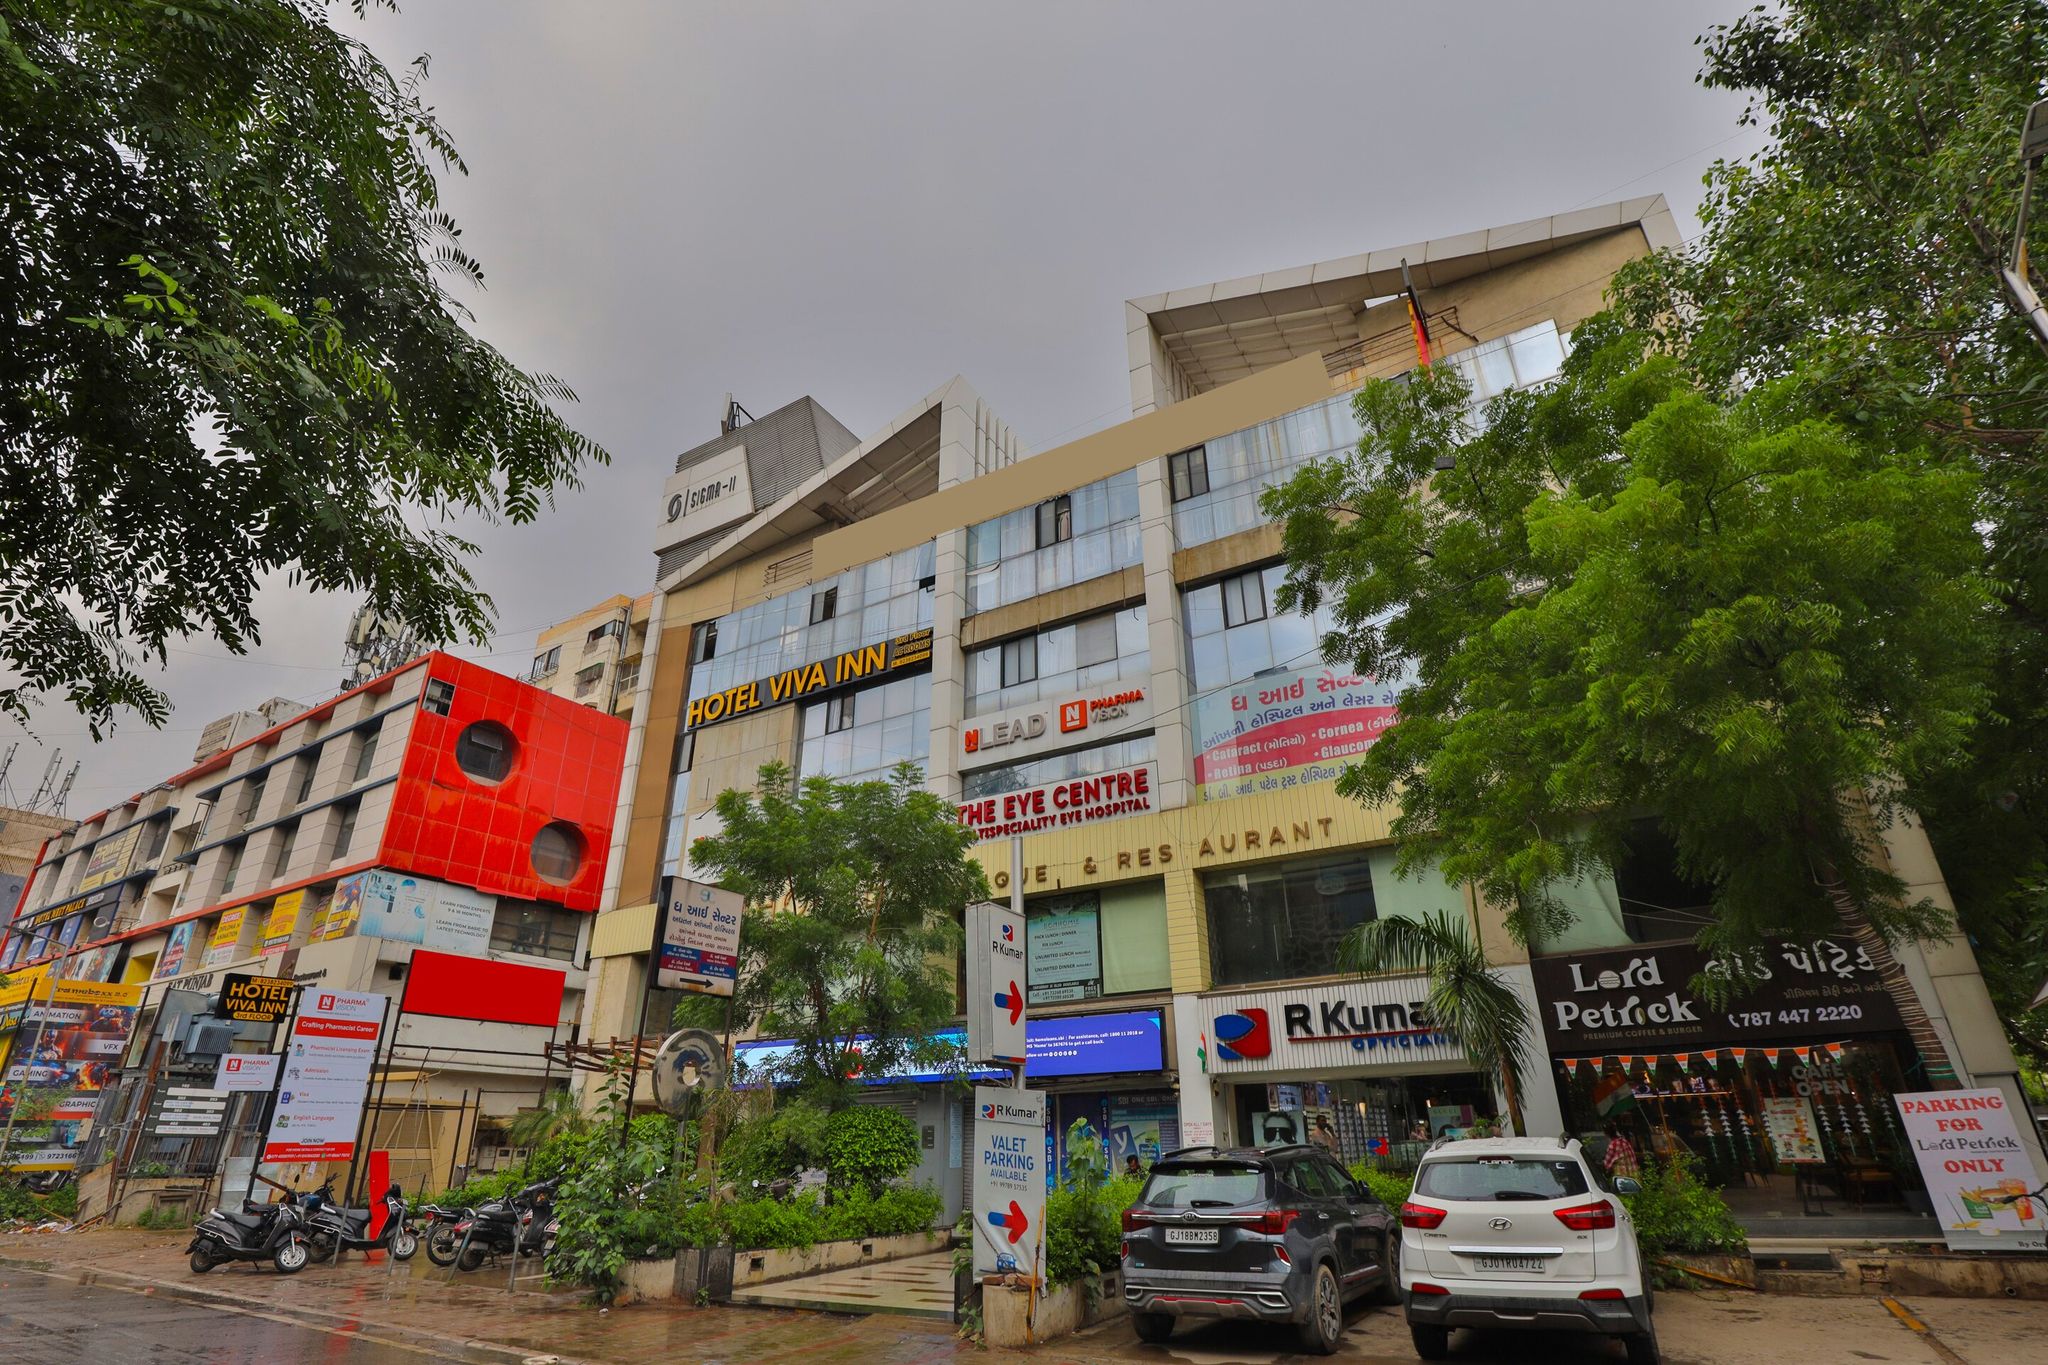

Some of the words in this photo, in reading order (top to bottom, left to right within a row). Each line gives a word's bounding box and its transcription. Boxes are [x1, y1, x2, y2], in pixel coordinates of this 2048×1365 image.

[904, 639, 931, 653] ROOMS
[688, 682, 761, 727] HOTEL
[769, 662, 828, 702] VIVA
[835, 642, 887, 683] INN
[1259, 677, 1305, 705] આઈ
[1090, 689, 1145, 712] PHARMA
[1310, 695, 1336, 712] અને
[1090, 704, 1129, 723] VISION
[1318, 722, 1364, 740] Cornea
[1212, 742, 1262, 762] Cataract
[1214, 764, 1253, 779] Retina
[957, 799, 997, 827] THE
[1004, 789, 1046, 819] EYE
[1053, 767, 1150, 809] CENTRE
[1060, 809, 1083, 825] EYE
[1085, 797, 1151, 820] HOSPITAL
[1083, 857, 1097, 875] &
[470, 906, 491, 914] EXPERTS
[687, 905, 709, 919] આઈ
[454, 929, 486, 938] TECHNOLOGY
[992, 941, 999, 953] R
[999, 941, 1024, 960] Kumar
[1034, 965, 1058, 973] UNLIMITED
[183, 974, 214, 991] PUNJAB
[230, 982, 289, 1001] HOTEL
[225, 998, 257, 1012] VIVA
[259, 1001, 286, 1014] INN
[335, 1004, 358, 1012] VISION
[336, 997, 367, 1007] PHARMA
[33, 1010, 82, 1020] ANMATION
[235, 1012, 248, 1020] 3rd
[248, 1013, 272, 1021] FLOOR
[1284, 1003, 1314, 1038] R
[1321, 1000, 1437, 1035] Kuma
[1553, 992, 1700, 1031] Petrick
[1740, 1011, 1772, 1027] 787
[1778, 1009, 1810, 1024] 447
[1815, 1004, 1863, 1022] 2220
[301, 1020, 324, 1030] Crafting
[325, 1023, 356, 1032] Pharmacist
[357, 1025, 375, 1033] Career
[1583, 1031, 1623, 1041] PREMIUM
[1625, 1028, 1657, 1038] COFFEE
[1667, 1026, 1703, 1034] BURGER
[103, 1043, 119, 1051] VFX
[1791, 1064, 1844, 1080] CAFE
[1796, 1079, 1850, 1097] OPEN
[996, 1104, 1004, 1116] R
[1005, 1105, 1038, 1120] Kumar
[1901, 1096, 2003, 1114] PARKING
[293, 1114, 312, 1122] English
[312, 1114, 336, 1122] Language
[1936, 1118, 1984, 1133] FOR
[992, 1135, 1026, 1153] VALET
[1917, 1138, 1956, 1152] Lord
[1957, 1136, 2019, 1150] Petrick
[984, 1150, 1034, 1171] PARKING
[1944, 1159, 2005, 1174] ONLY
[990, 1168, 1028, 1182] AVAILABLE
[1169, 1230, 1218, 1241] GJ18BM2358
[2018, 1241, 2030, 1249] By
